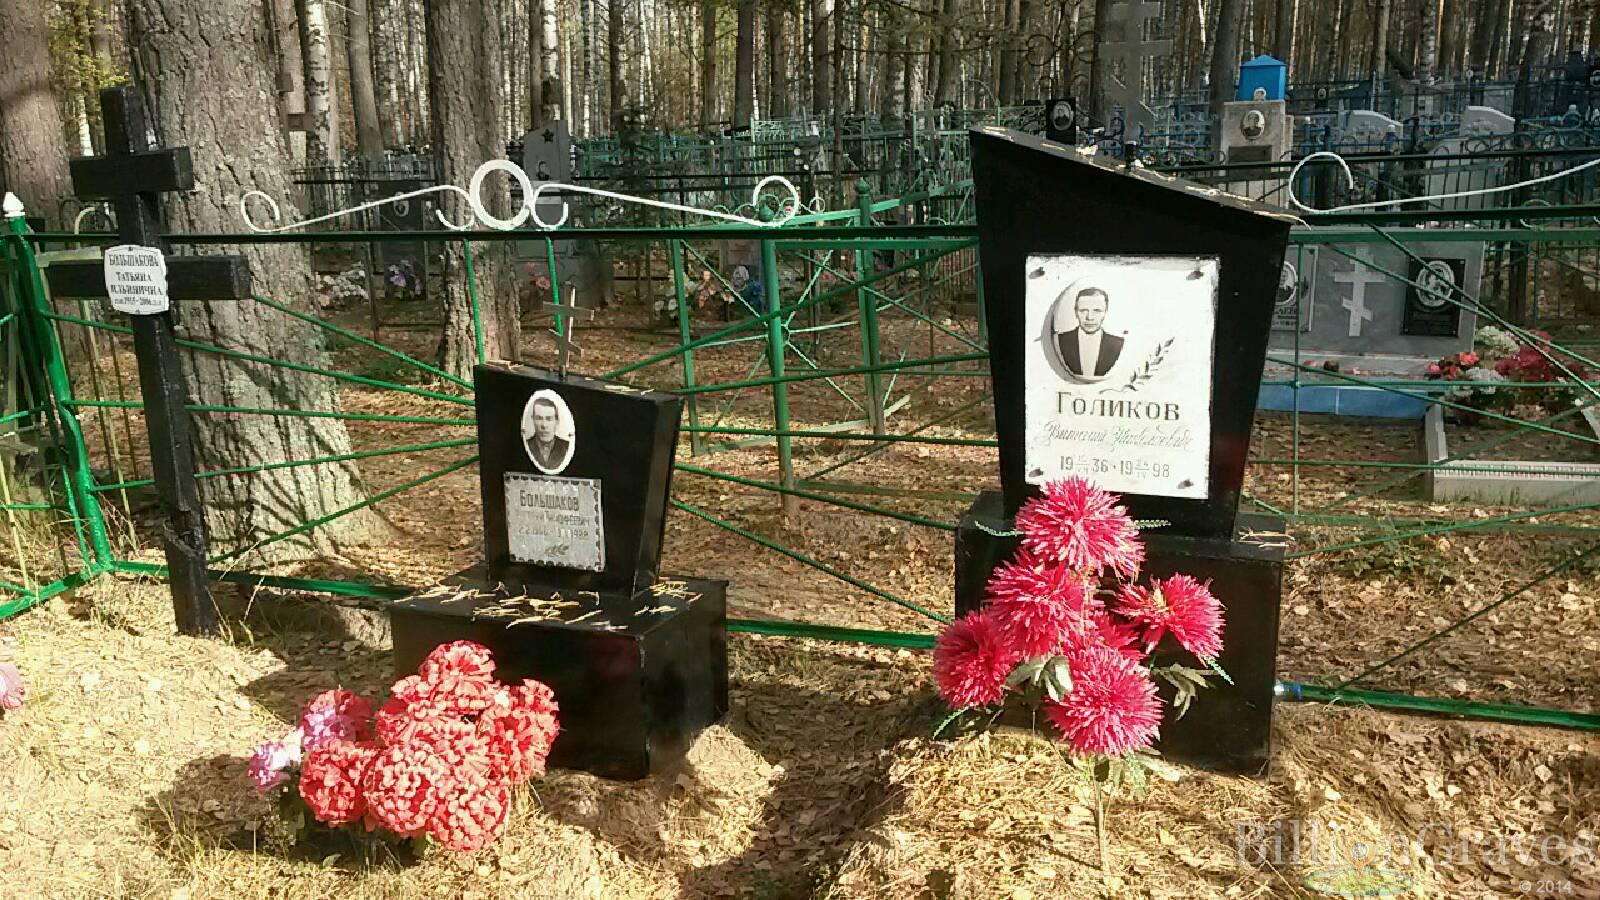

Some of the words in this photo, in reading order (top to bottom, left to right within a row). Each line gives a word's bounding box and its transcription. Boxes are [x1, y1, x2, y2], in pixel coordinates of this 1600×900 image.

[108, 254, 159, 267] БОЛЬШАКОВА
[115, 271, 153, 282] ТАТЬЯНА
[110, 284, 163, 296] ИЛЬИНИЧНА
[519, 489, 579, 512] БОЛЬШАКОВ
